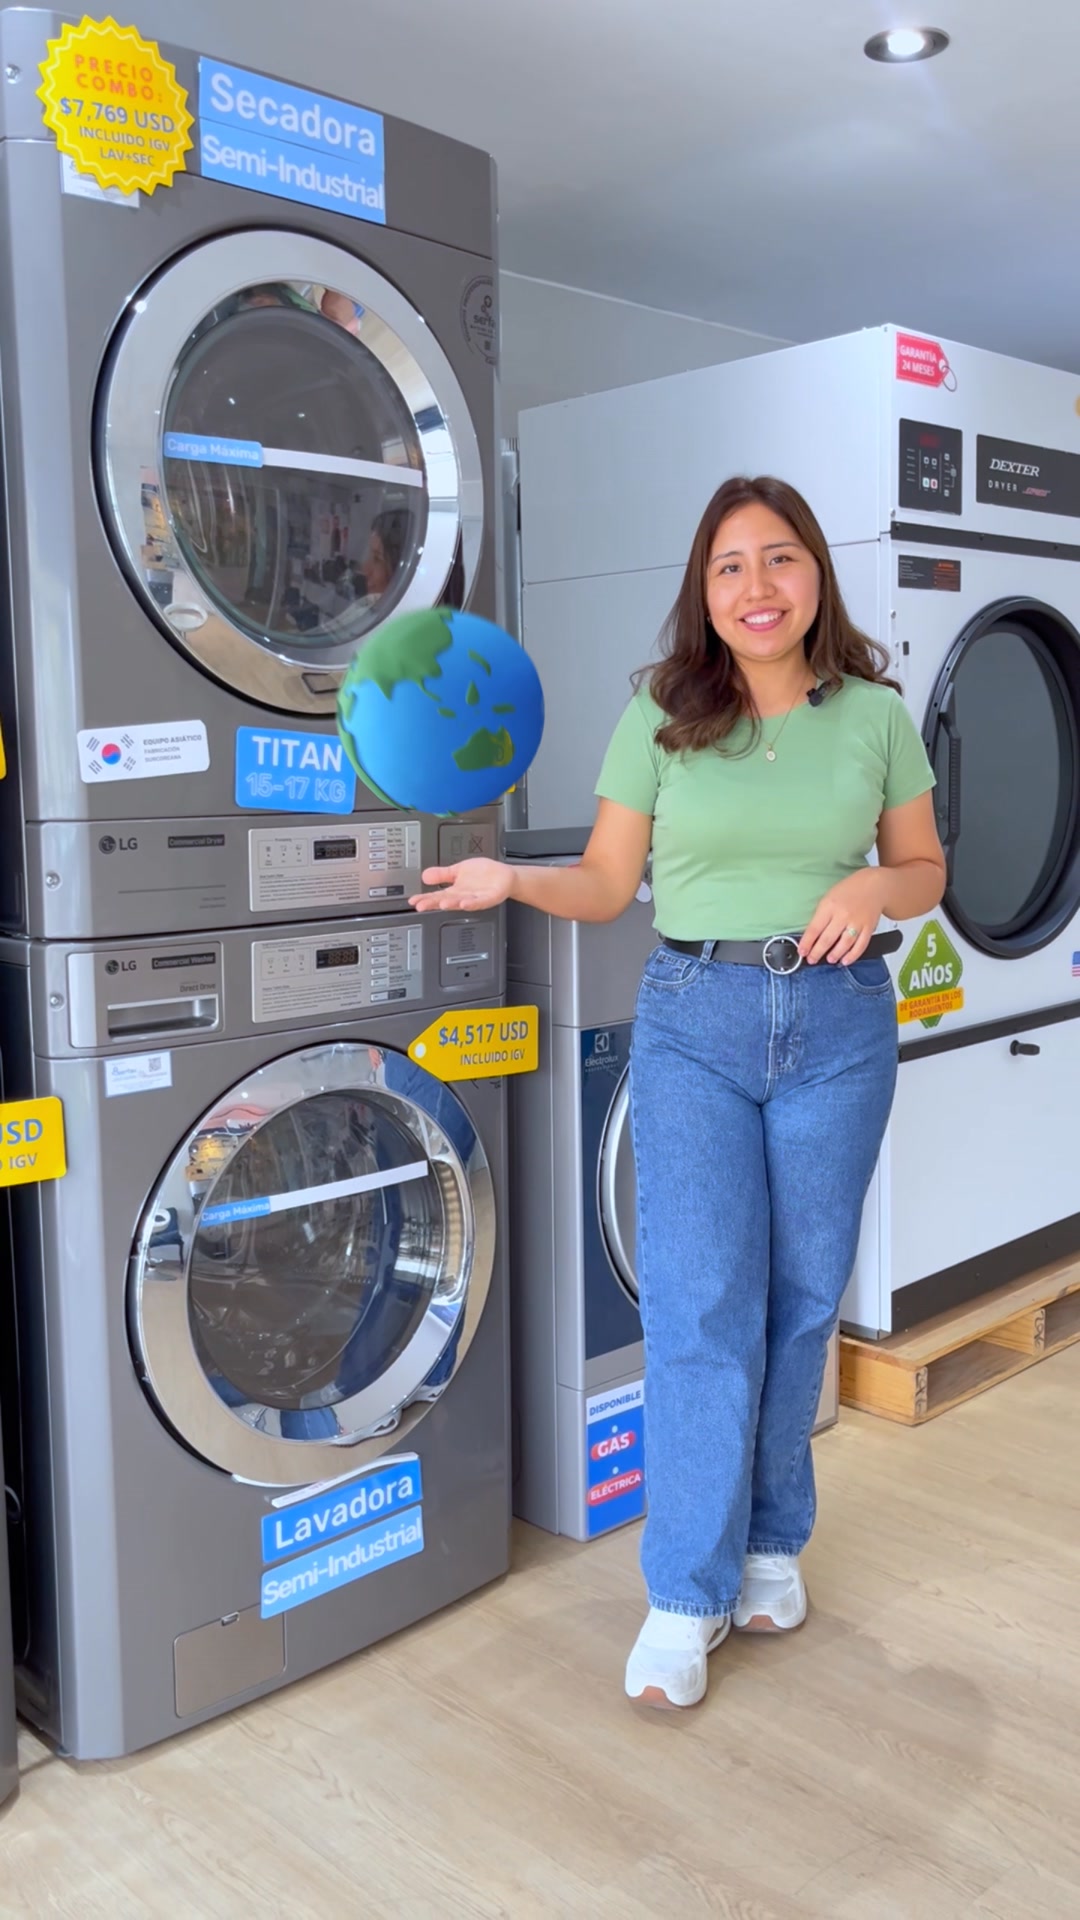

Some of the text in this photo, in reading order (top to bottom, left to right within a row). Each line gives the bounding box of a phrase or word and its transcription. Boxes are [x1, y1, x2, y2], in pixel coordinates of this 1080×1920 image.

[75, 54, 153, 83] PRECIO
[76, 73, 163, 103] COMBO:
[60, 97, 175, 133] $7,769 USD
[210, 71, 375, 156] Secadora
[80, 127, 170, 152] INCLUIDO IGV
[100, 147, 154, 167] LAV+SEC
[202, 135, 384, 210] Semi-Industrial
[902, 359, 935, 377] 24 MESES
[167, 438, 259, 461] Carga Máxima
[989, 458, 1040, 477] DEXTER
[988, 480, 1017, 492] DRYER
[143, 738, 169, 746] EQUIPO
[252, 736, 343, 772] TITAN
[246, 772, 346, 803] 15-17 KG
[119, 837, 138, 851] LG
[926, 933, 937, 958] 5
[121, 960, 137, 972] LG
[909, 961, 953, 991] AÑOS
[438, 1020, 529, 1049] $4,517 USD
[460, 1048, 525, 1066] INCLUIDO IGV
[585, 1055, 619, 1067] Electrolux
[9, 1153, 38, 1169] IGV
[202, 1199, 270, 1222] Carga Máxima
[589, 1390, 641, 1416] DISPONIBLE
[597, 1433, 630, 1458] GAS
[275, 1476, 413, 1550] Lavadora
[263, 1517, 422, 1605] Semi-Industrial
